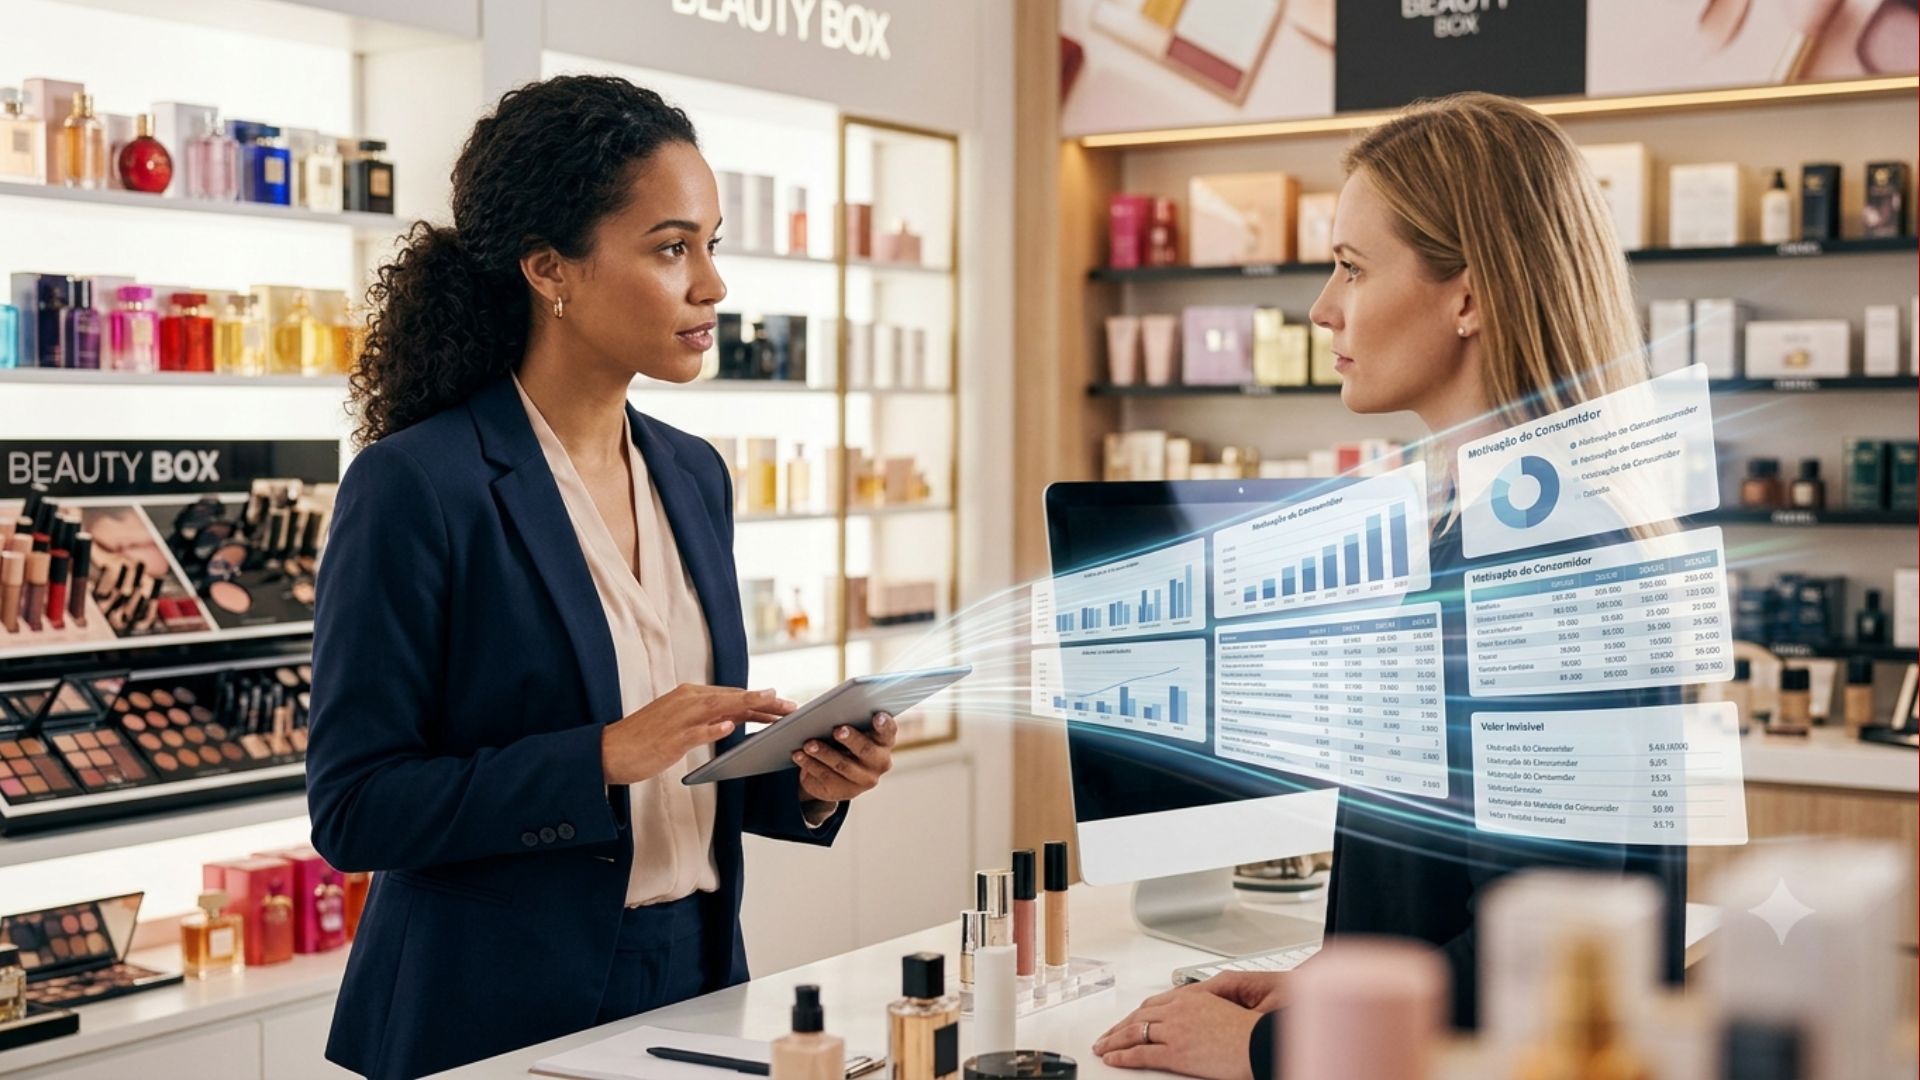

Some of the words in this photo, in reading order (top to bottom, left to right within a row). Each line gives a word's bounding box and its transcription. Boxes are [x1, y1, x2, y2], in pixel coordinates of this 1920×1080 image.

[821, 0, 891, 60] BOX
[1434, 14, 1480, 38] BOX
[8, 450, 143, 484] BEAUTY
[152, 450, 220, 482] BOX
